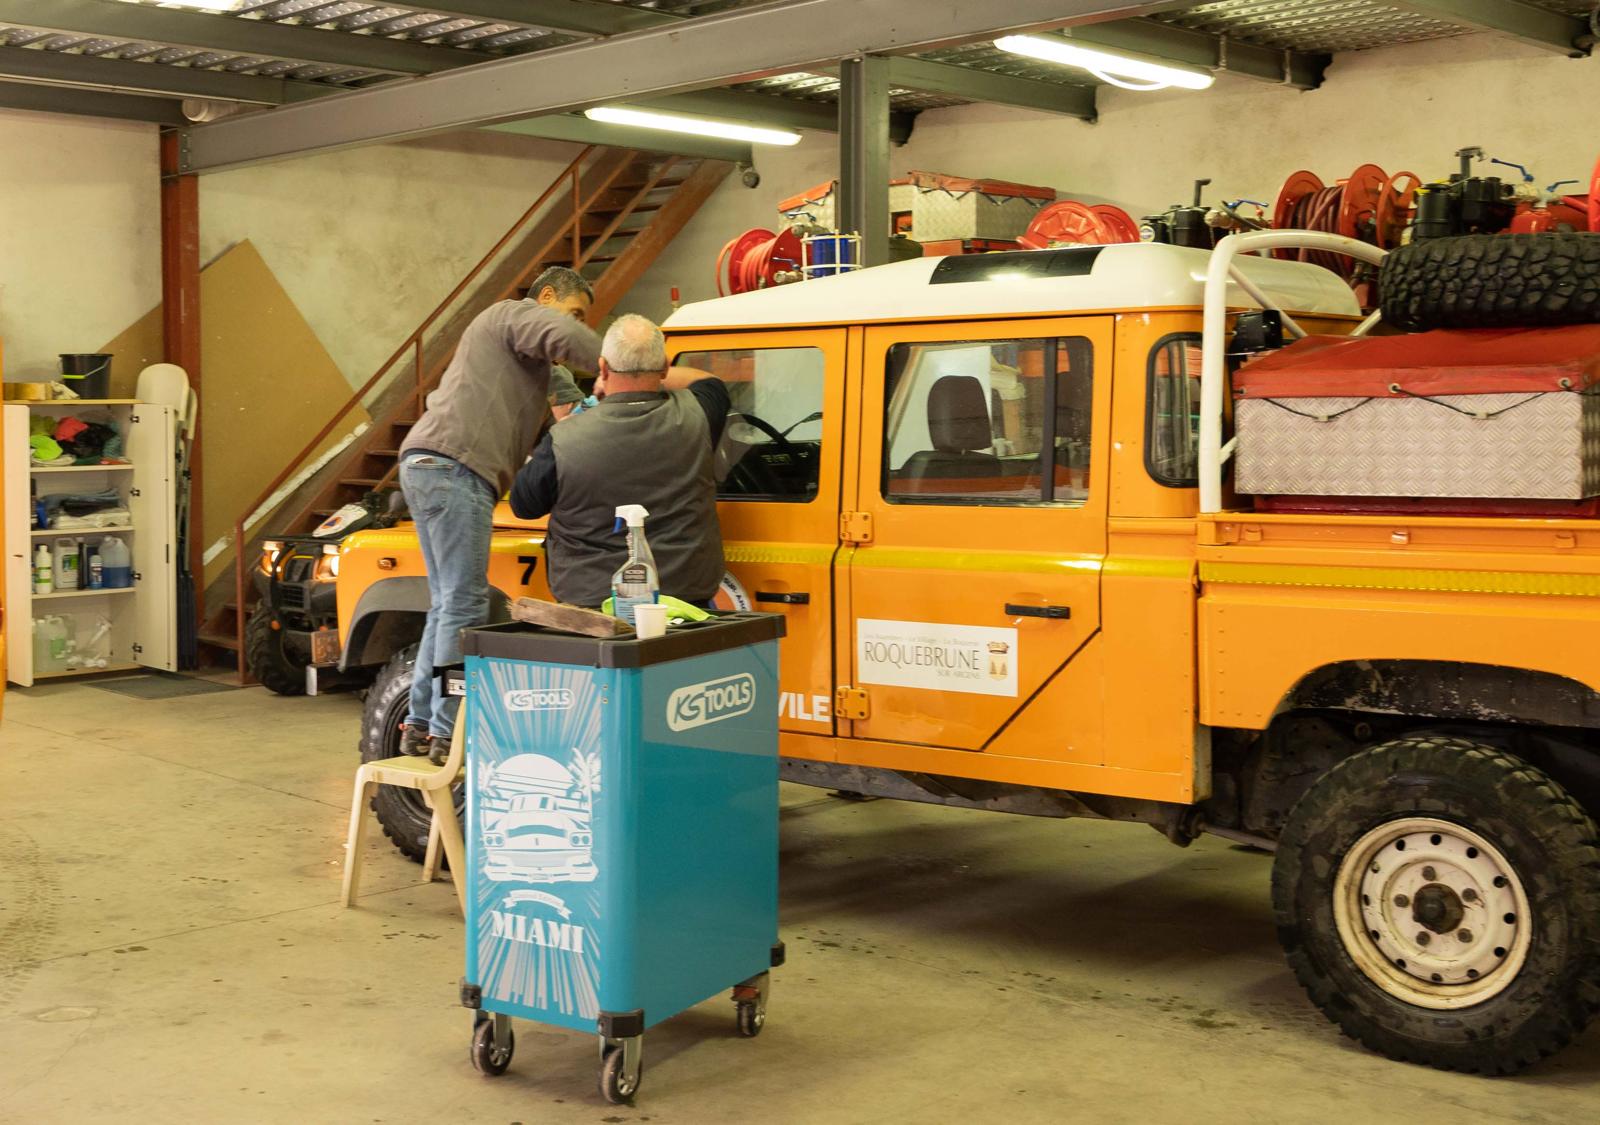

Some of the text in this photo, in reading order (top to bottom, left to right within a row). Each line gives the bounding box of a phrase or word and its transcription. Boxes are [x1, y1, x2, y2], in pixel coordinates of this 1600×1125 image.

[518, 555, 538, 585] 7
[864, 641, 980, 670] ROQUEBRUNE
[531, 691, 570, 706] TOOLS
[704, 681, 750, 713] TOOLS
[491, 910, 584, 953] MIAMI
